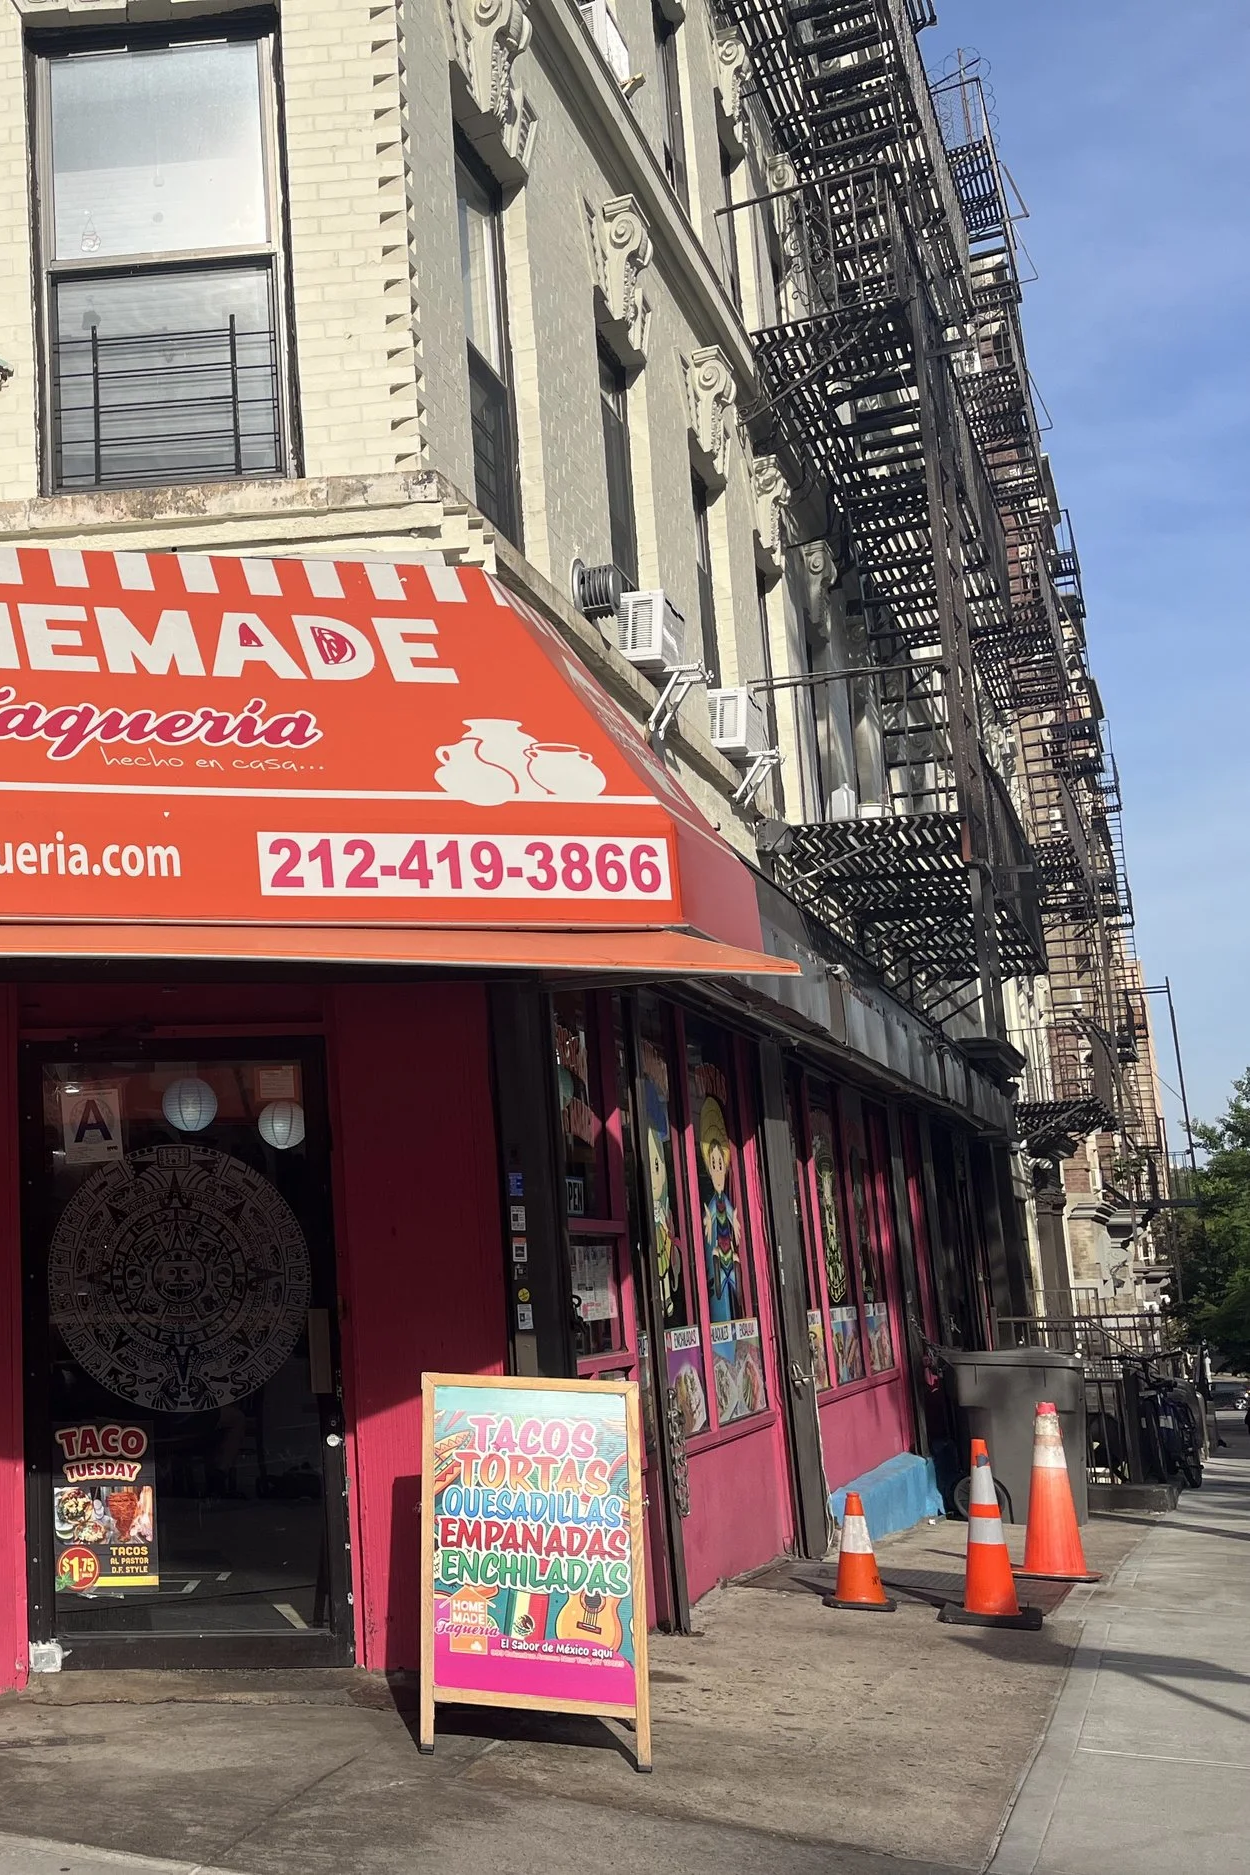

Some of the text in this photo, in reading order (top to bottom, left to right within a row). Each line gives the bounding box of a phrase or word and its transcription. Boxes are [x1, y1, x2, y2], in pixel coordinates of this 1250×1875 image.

[100, 746, 184, 768] hecho
[195, 758, 225, 771] en
[268, 837, 662, 894] 212-419-3866
[74, 1099, 113, 1143] A
[59, 1428, 145, 1456] TACO
[469, 1418, 593, 1455] TACOS
[66, 1463, 137, 1479] TUESDAY
[456, 1453, 608, 1495] TORTAS
[445, 1487, 622, 1526] QUESADILLAS
[110, 1547, 148, 1556] TACOS
[440, 1518, 627, 1562] EMPANADAS
[62, 1557, 95, 1581] $1.75
[442, 1551, 630, 1595] ENCHILADAS
[453, 1600, 485, 1613] HOME
[453, 1613, 485, 1626] MADE
[501, 1639, 613, 1659] El Sabor de México aquí
